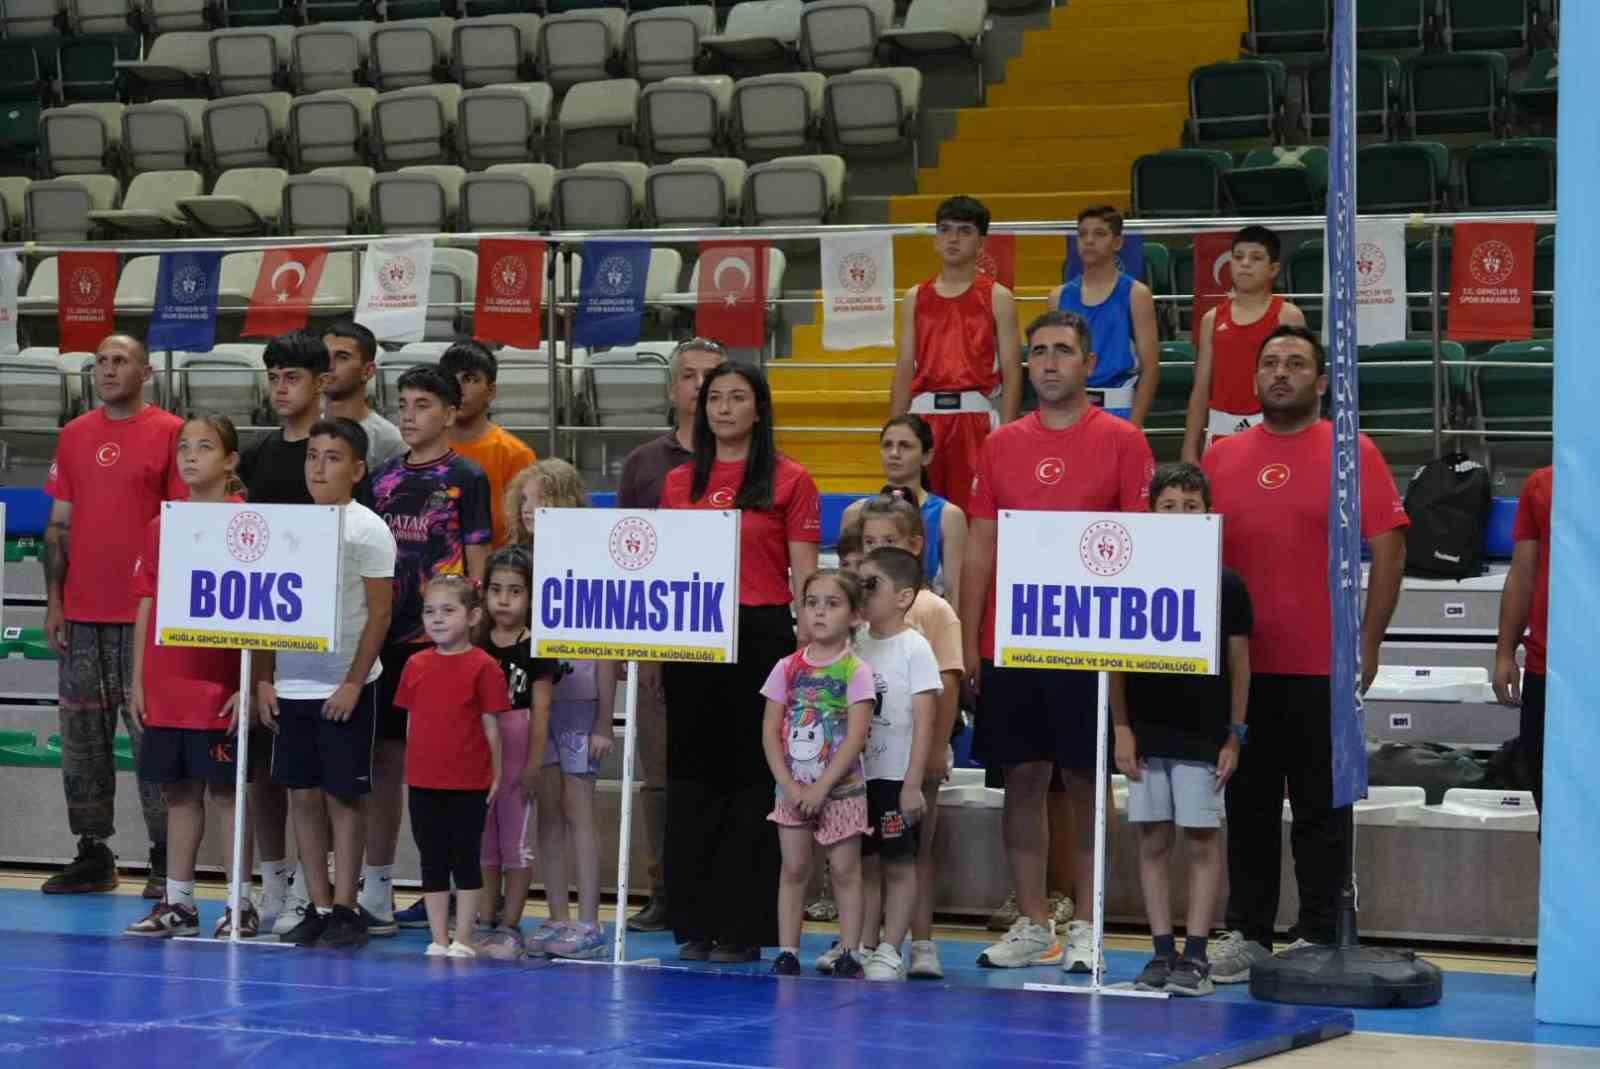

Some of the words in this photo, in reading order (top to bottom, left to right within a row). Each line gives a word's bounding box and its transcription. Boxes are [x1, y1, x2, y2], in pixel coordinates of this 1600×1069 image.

[190, 570, 303, 622] BOKS
[541, 569, 725, 633] CİMNASTİK
[1012, 584, 1201, 642] HENTBOL
[169, 633, 194, 642] MUĞLA
[196, 634, 228, 645] GENÇLİK
[230, 636, 240, 645] VE
[240, 637, 260, 646] SPOR
[271, 638, 319, 650] MÜDÜRLÜĞÜ
[546, 644, 575, 653] MUĞLA
[577, 645, 612, 657] GENÇLİK
[615, 647, 625, 656] VE
[626, 648, 648, 657] SPOR
[660, 649, 715, 661] MÜDÜRLÜĞÜ
[1011, 653, 1043, 664] MUĞLA
[1046, 655, 1083, 667] GENÇLİK
[1086, 657, 1097, 667] VE
[1098, 658, 1123, 668] SPOR
[1135, 659, 1195, 672] MÜDÜRLÜĞÜ
